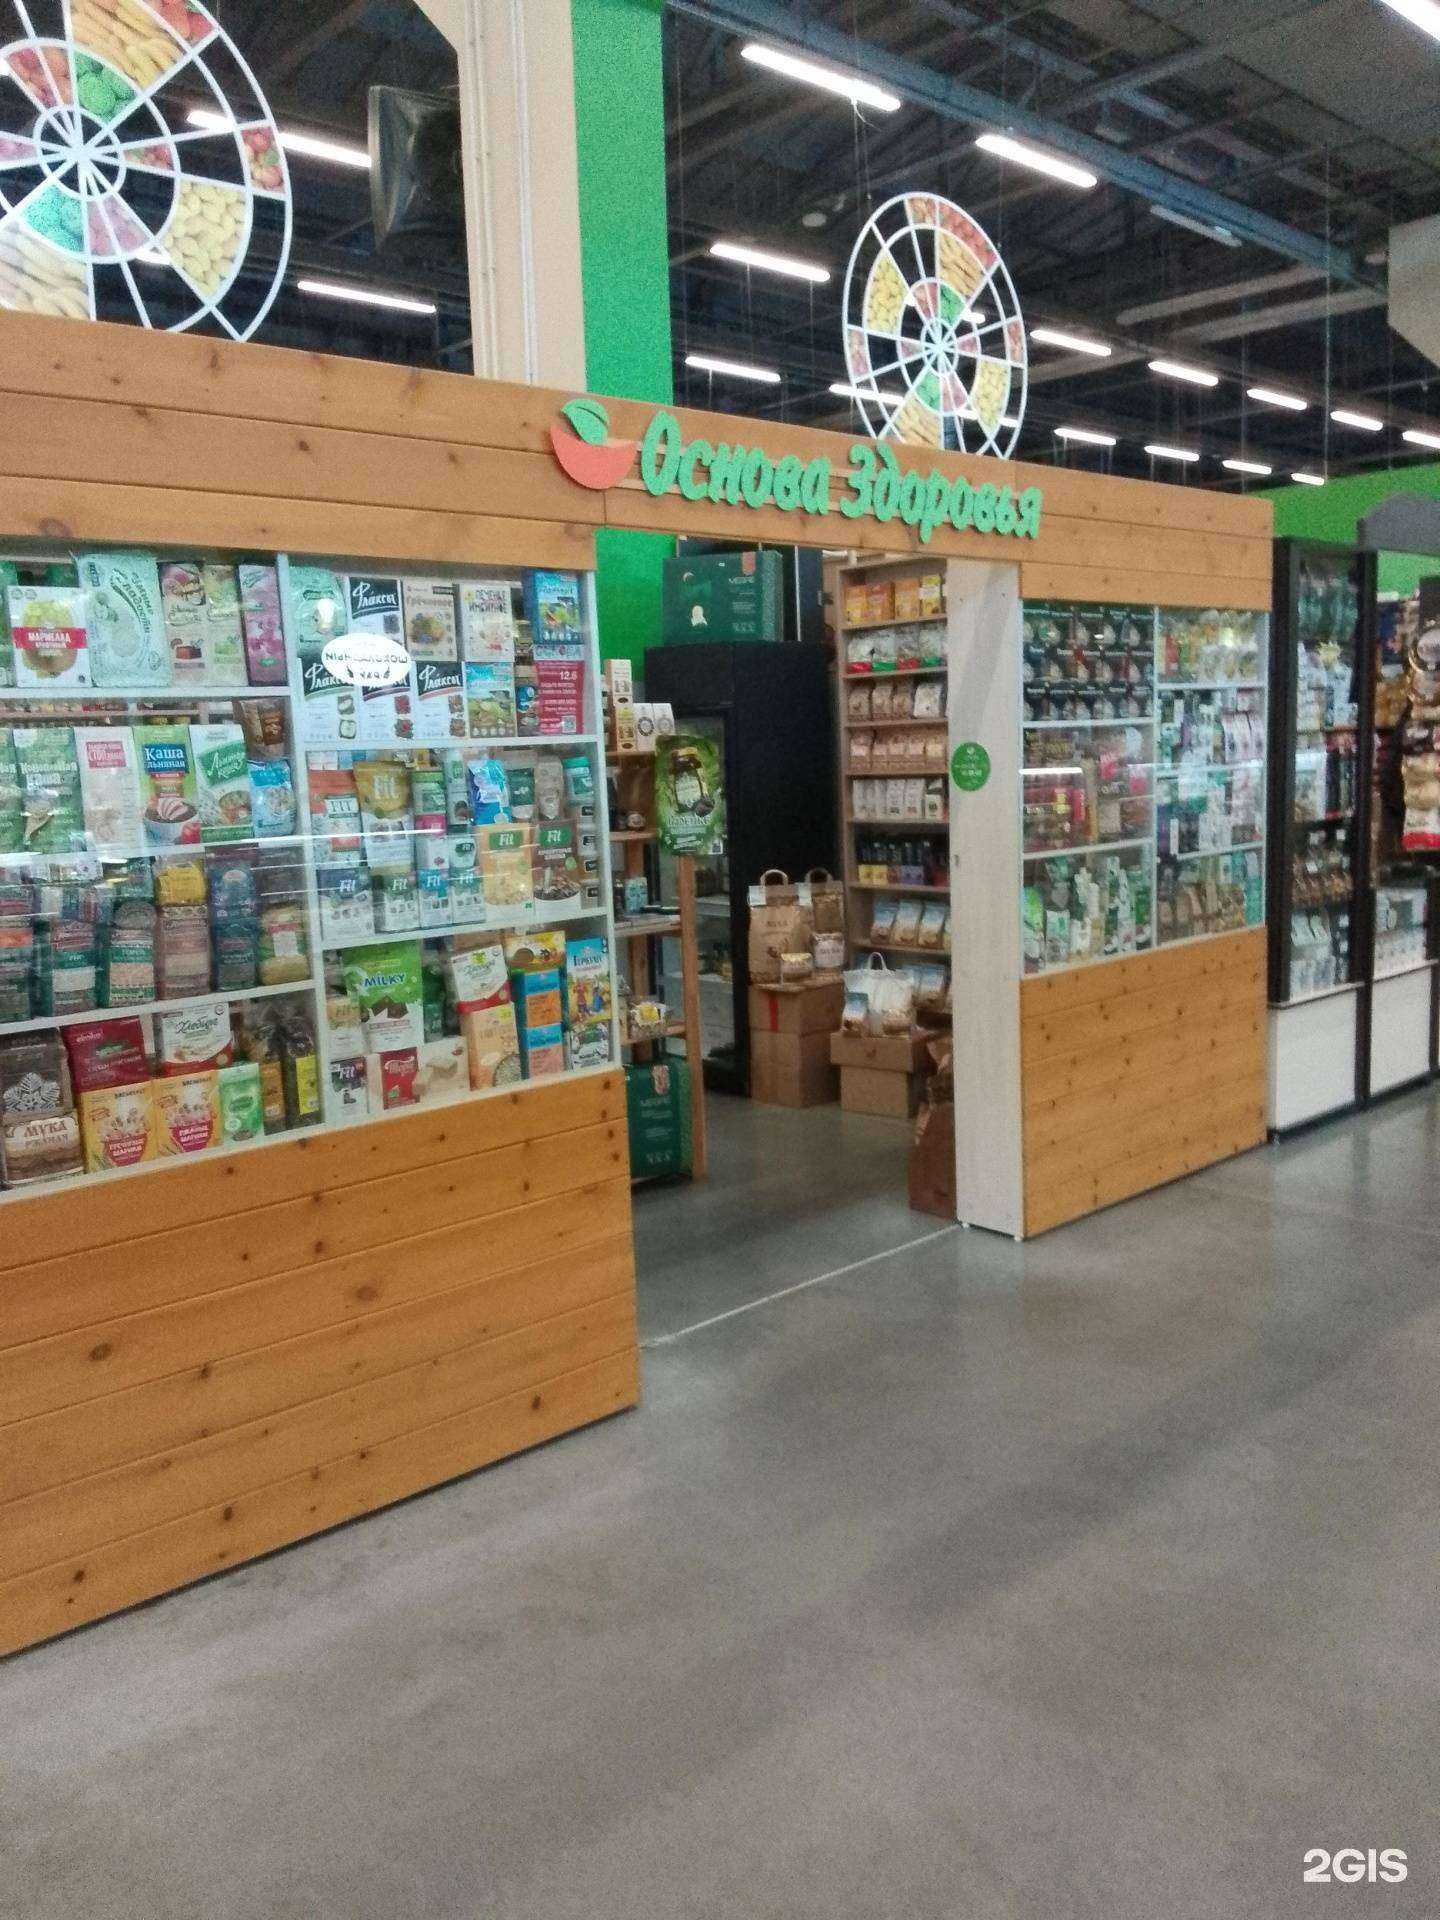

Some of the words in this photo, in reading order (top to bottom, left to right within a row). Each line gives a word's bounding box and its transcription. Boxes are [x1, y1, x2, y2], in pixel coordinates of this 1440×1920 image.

[641, 410, 831, 516] Основа
[840, 440, 1044, 544] Здоровья
[144, 747, 184, 761] Каша
[147, 760, 186, 769] льняная
[364, 973, 405, 987] MILKY
